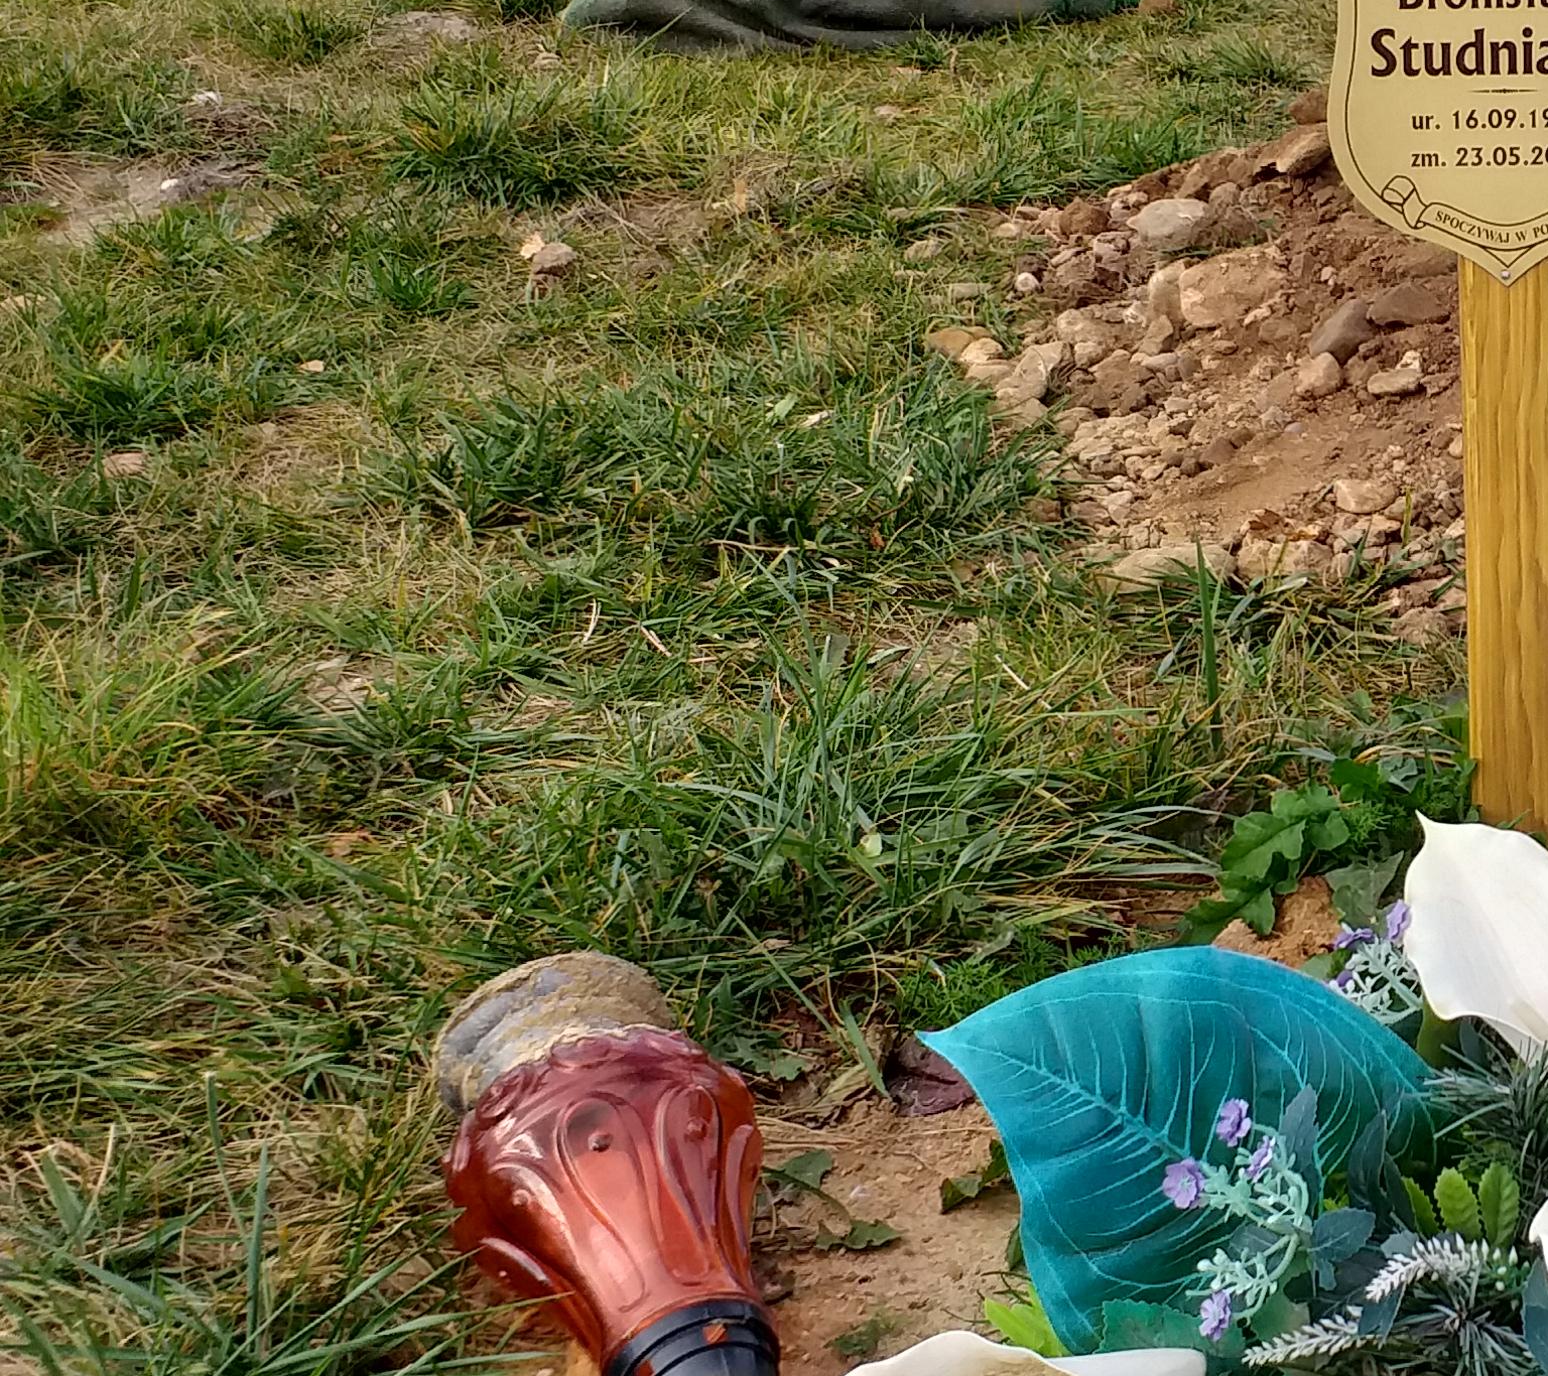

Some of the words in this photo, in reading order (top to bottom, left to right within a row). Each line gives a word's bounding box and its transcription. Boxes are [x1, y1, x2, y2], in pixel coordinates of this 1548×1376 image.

[1411, 114, 1441, 130] ur.
[1411, 152, 1447, 167] zm.
[1435, 210, 1510, 243] SPOCZYWAJ
[1515, 231, 1528, 242] W
